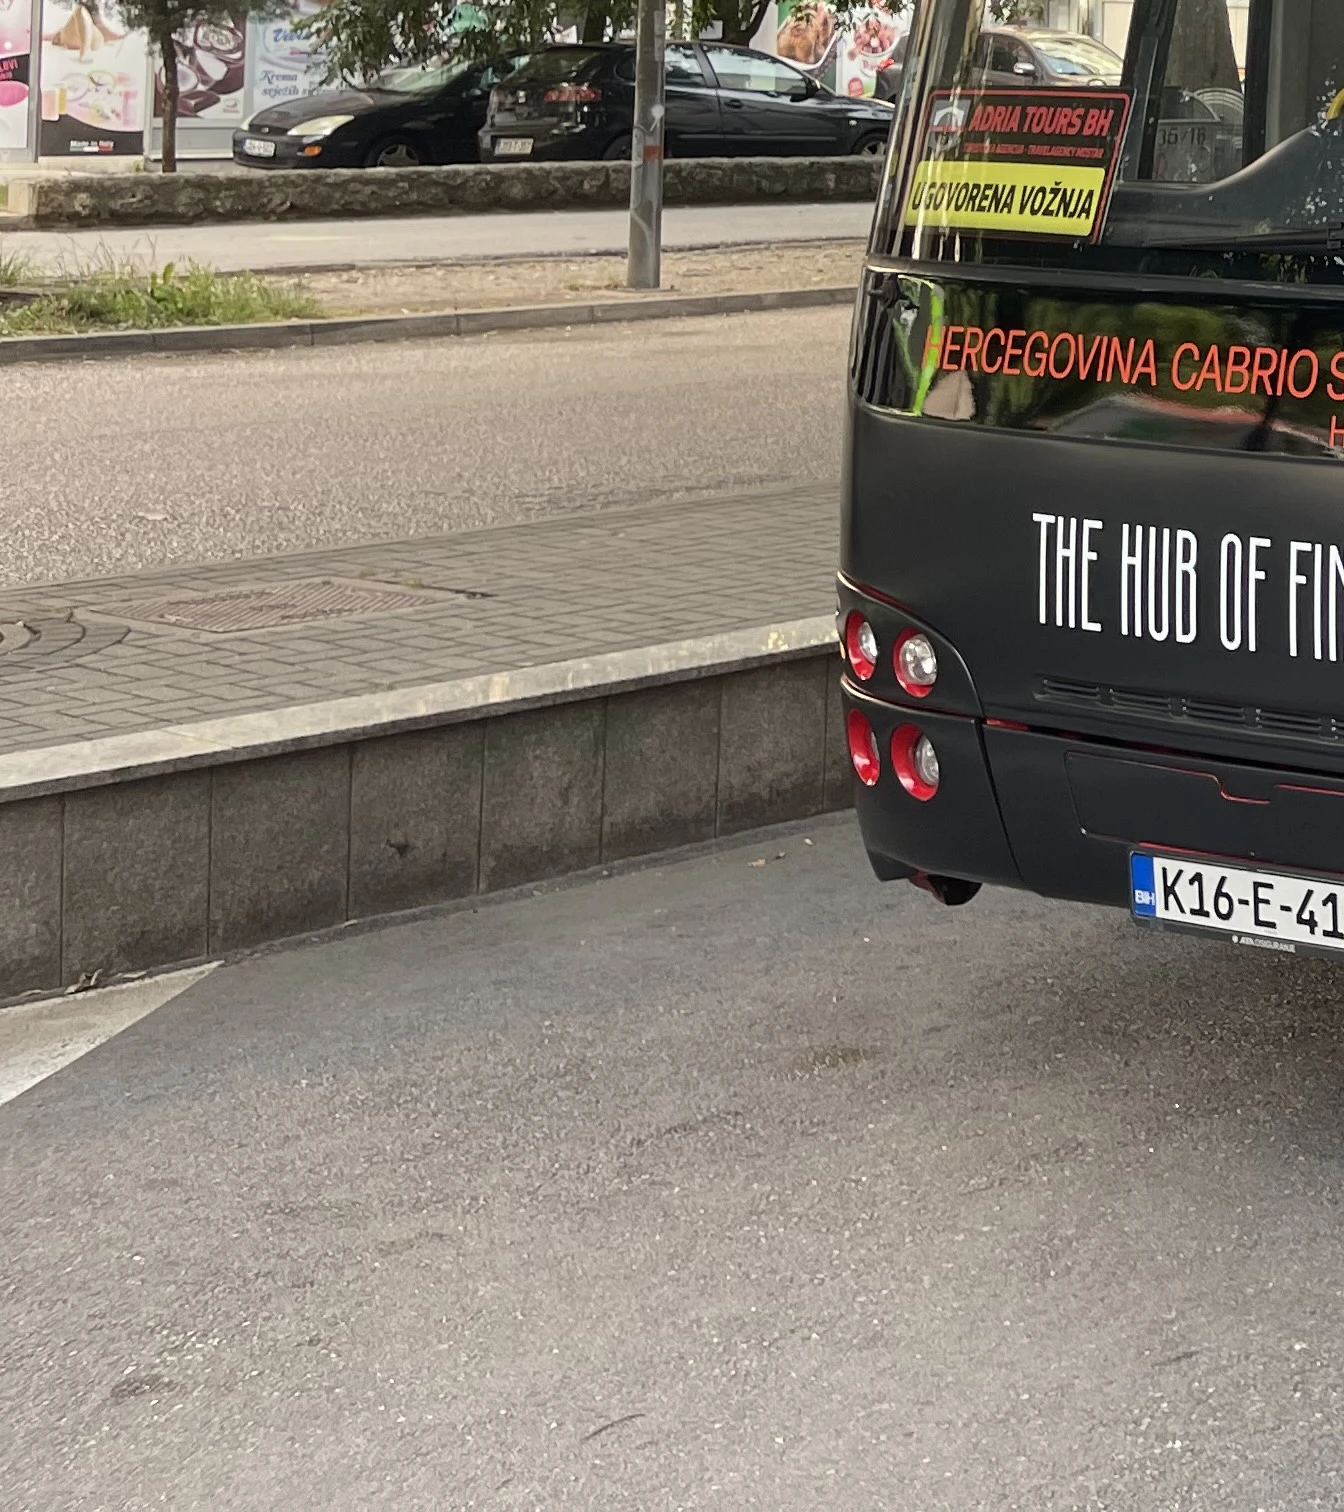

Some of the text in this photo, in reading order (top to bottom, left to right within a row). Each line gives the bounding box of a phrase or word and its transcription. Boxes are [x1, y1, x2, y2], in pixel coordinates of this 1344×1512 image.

[969, 104, 1115, 137] ADRIA TOURS BH
[912, 181, 1094, 220] UGOVORENA VOŽNJA
[920, 324, 1157, 388] HERCEGOVINA
[1170, 340, 1319, 400] CABRIO
[1032, 511, 1103, 634] THE
[1119, 524, 1197, 646] HUB
[1219, 532, 1271, 654] OF
